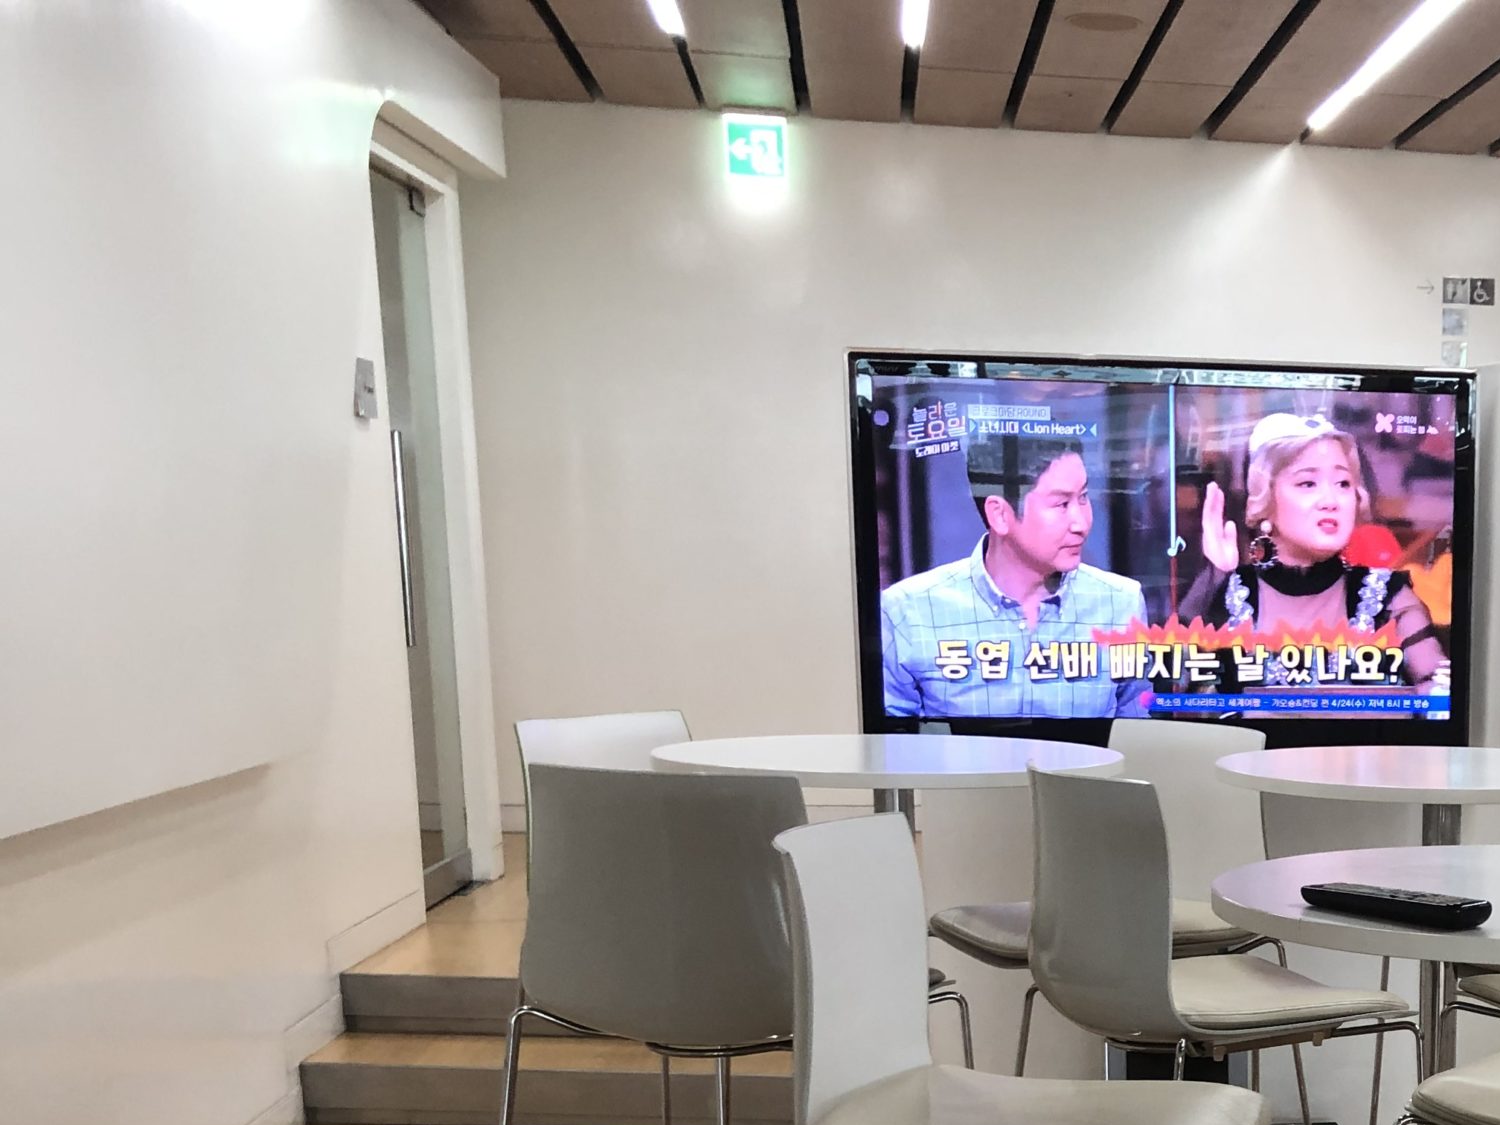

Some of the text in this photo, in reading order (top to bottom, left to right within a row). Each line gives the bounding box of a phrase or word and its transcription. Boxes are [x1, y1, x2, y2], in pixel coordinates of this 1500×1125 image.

[907, 415, 968, 445] 토요일
[934, 639, 1405, 685] 동엽 선배 빠지는 날 있나요?
[1331, 699, 1367, 709] 4/24(수)
[1368, 699, 1385, 709] 저녁
[1387, 699, 1401, 709] 8시
[1413, 699, 1430, 709] 방송
